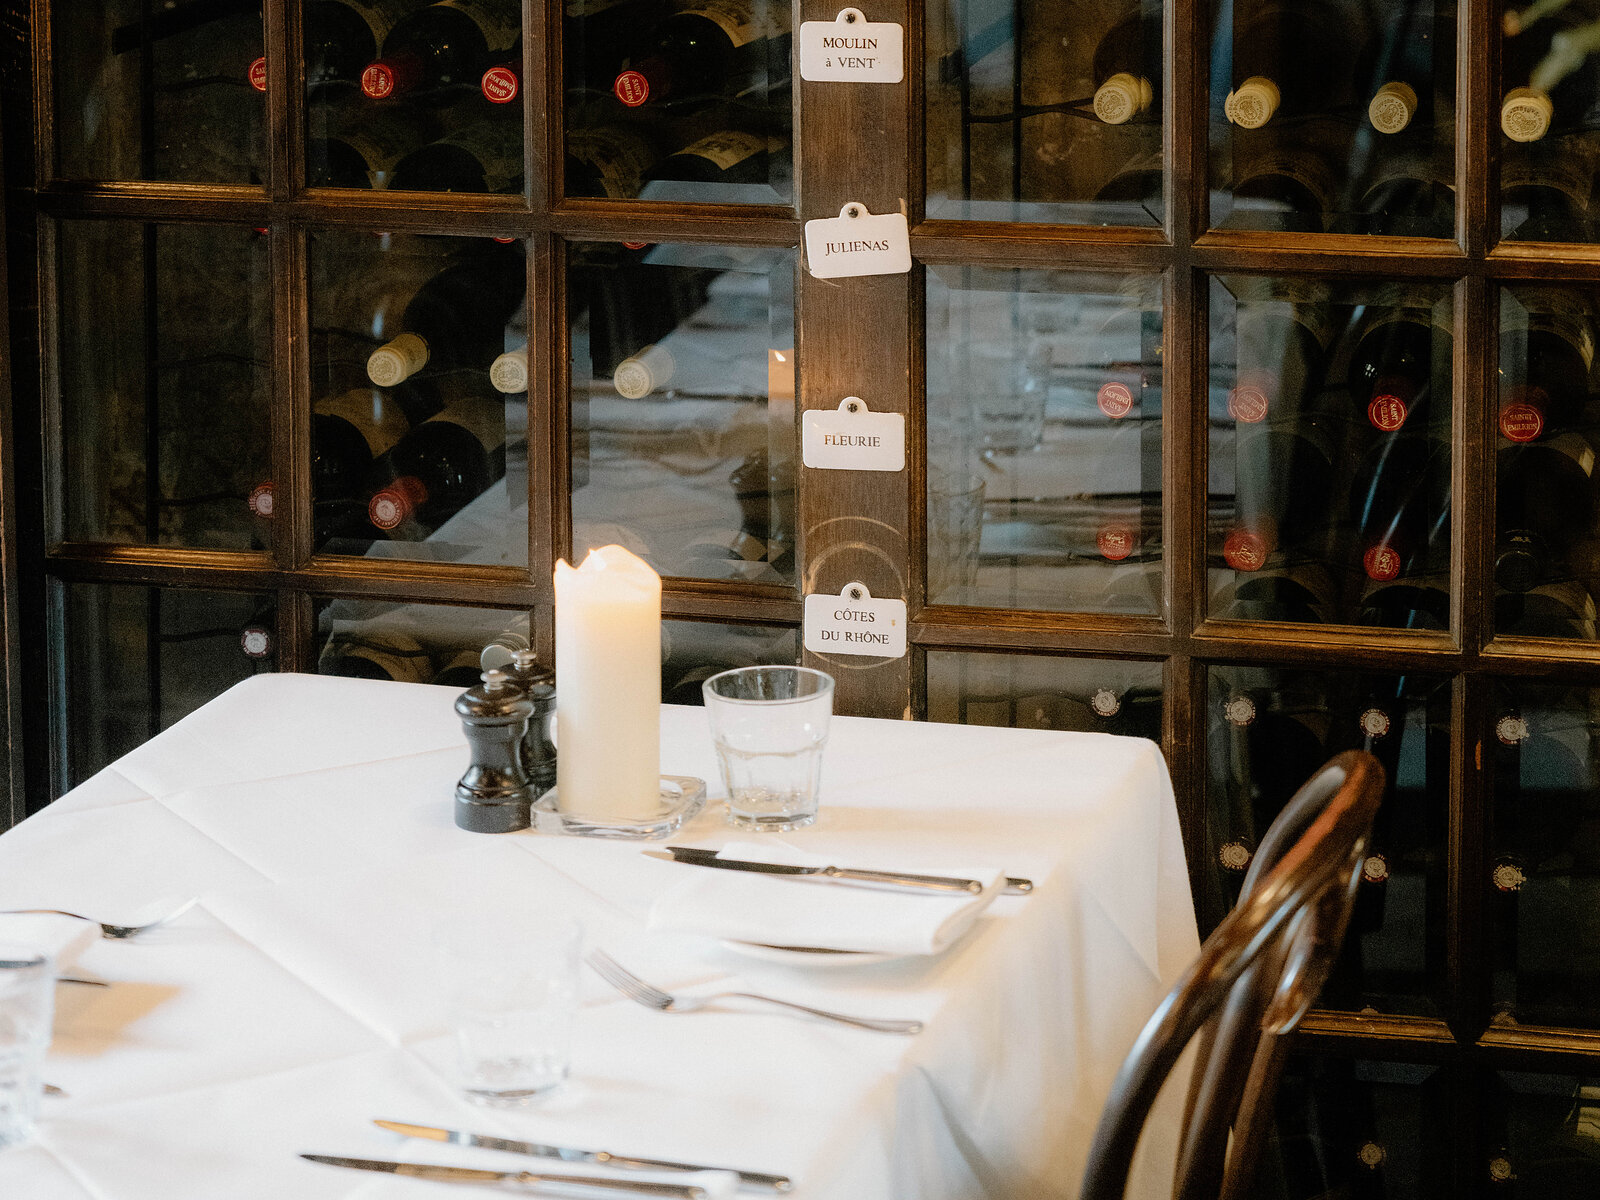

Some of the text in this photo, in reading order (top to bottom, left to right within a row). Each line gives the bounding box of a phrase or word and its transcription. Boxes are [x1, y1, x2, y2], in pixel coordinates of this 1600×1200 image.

[822, 36, 879, 50] MOULIN
[825, 56, 877, 69] à VENT
[632, 78, 642, 97] SAINT
[824, 239, 890, 256] JULIENAS
[824, 434, 881, 448] FLEURIE
[833, 607, 876, 623] CÔTES
[820, 629, 890, 646] DU RHÔNE
